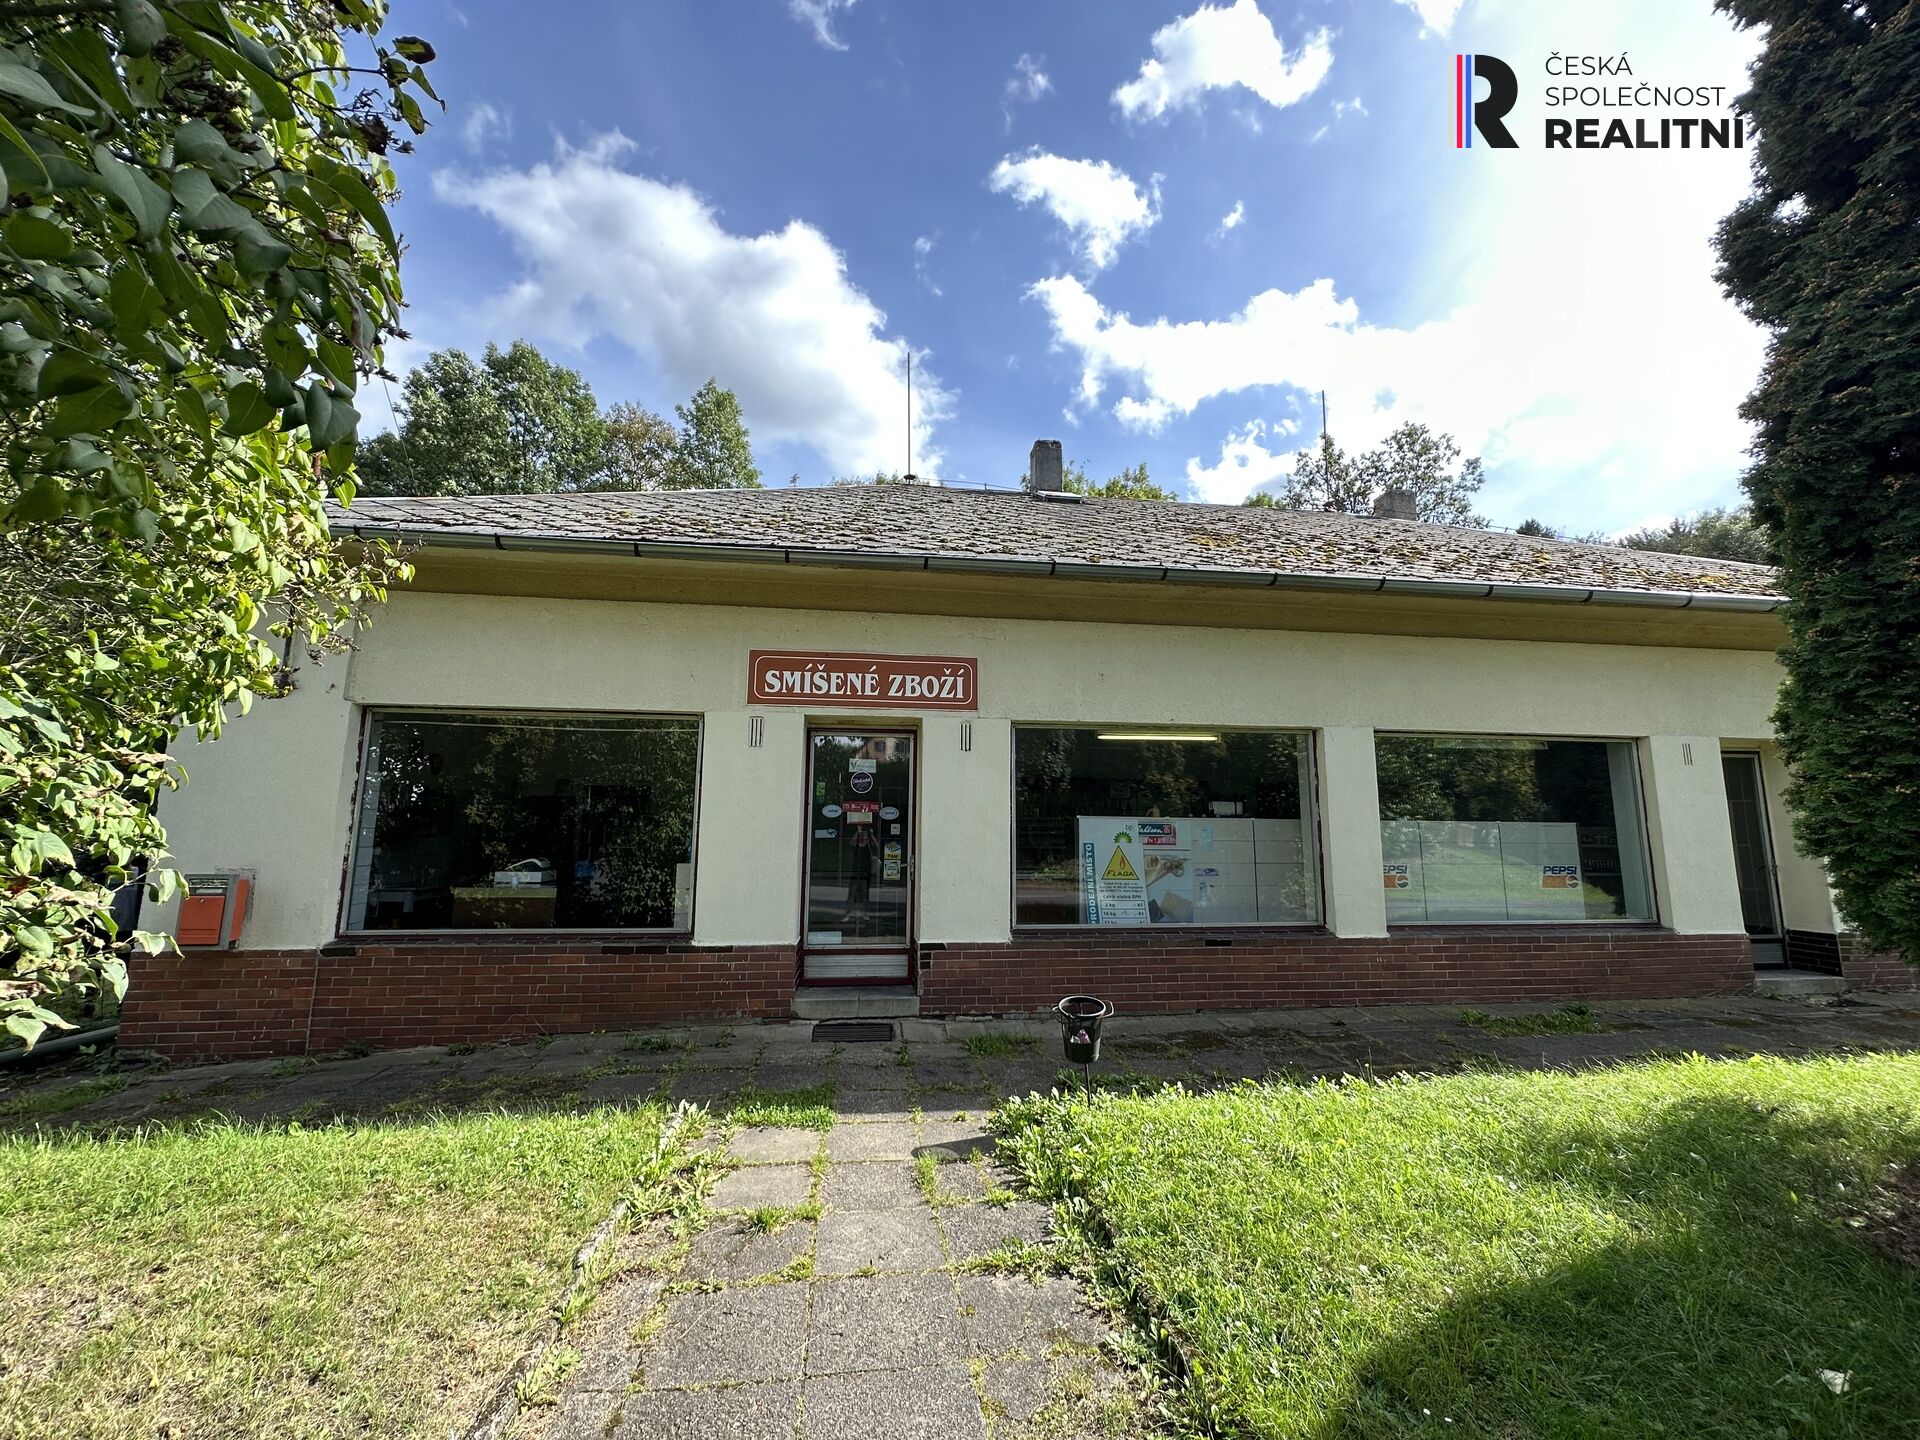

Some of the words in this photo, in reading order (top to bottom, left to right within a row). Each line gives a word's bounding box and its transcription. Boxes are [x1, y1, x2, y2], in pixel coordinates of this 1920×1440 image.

[764, 663, 880, 696] SMÍŠENÉ
[888, 667, 964, 699] ZBOŽÍ
[1383, 865, 1408, 875] EPSI
[1543, 865, 1577, 875] PEPSI
